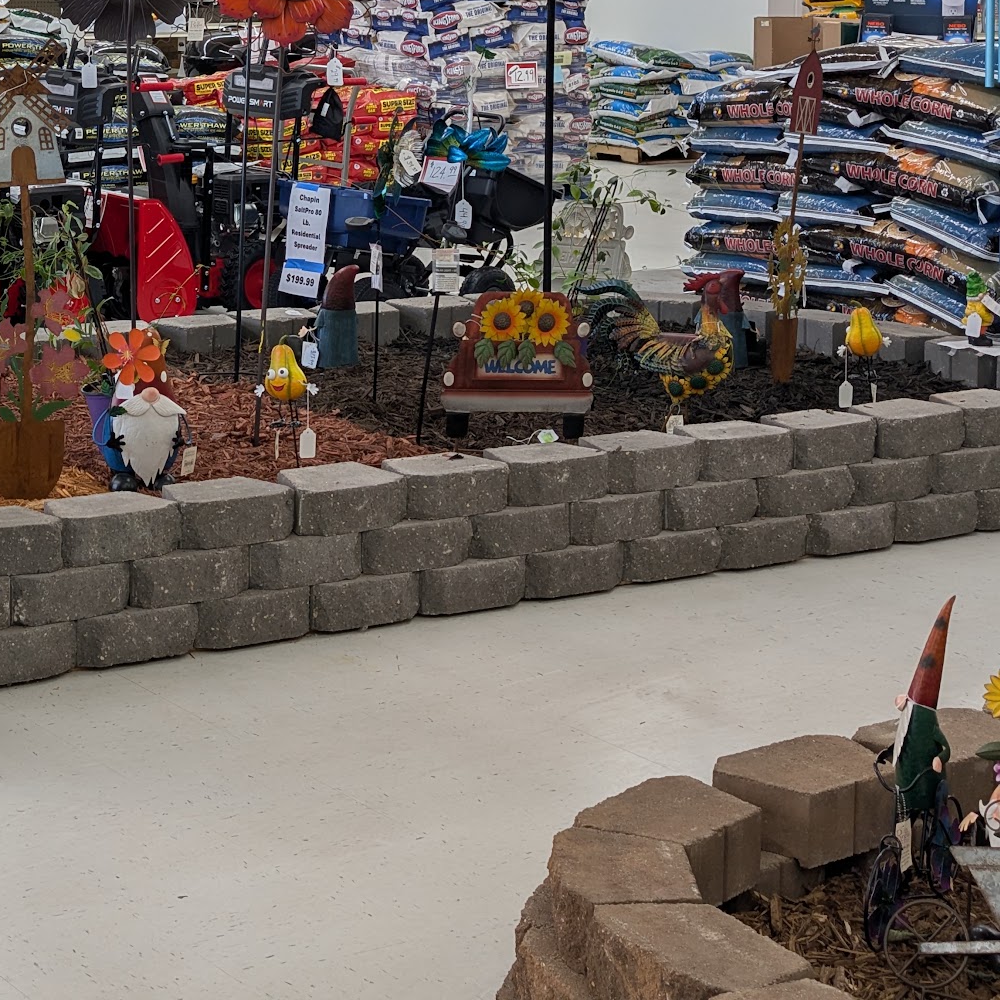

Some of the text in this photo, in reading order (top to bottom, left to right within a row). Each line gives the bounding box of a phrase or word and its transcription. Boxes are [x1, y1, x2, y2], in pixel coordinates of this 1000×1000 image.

[433, 14, 461, 26] KINGSFORD
[566, 32, 588, 42] KINGSFORD
[196, 82, 216, 92] SUPER
[228, 96, 273, 108] POWESMART
[855, 87, 954, 120] WHOLE CORN
[726, 102, 774, 119] WHOLE
[722, 167, 799, 186] WHOLE CORN
[846, 163, 939, 198] WHOLE CORN
[299, 194, 320, 204] Chapin
[302, 218, 311, 227] Lb.
[292, 229, 321, 241] Residential
[294, 241, 318, 252] Spreader
[724, 237, 771, 254] WHOLE
[850, 242, 944, 283] WHOLE CORN
[286, 273, 315, 288] $199.99
